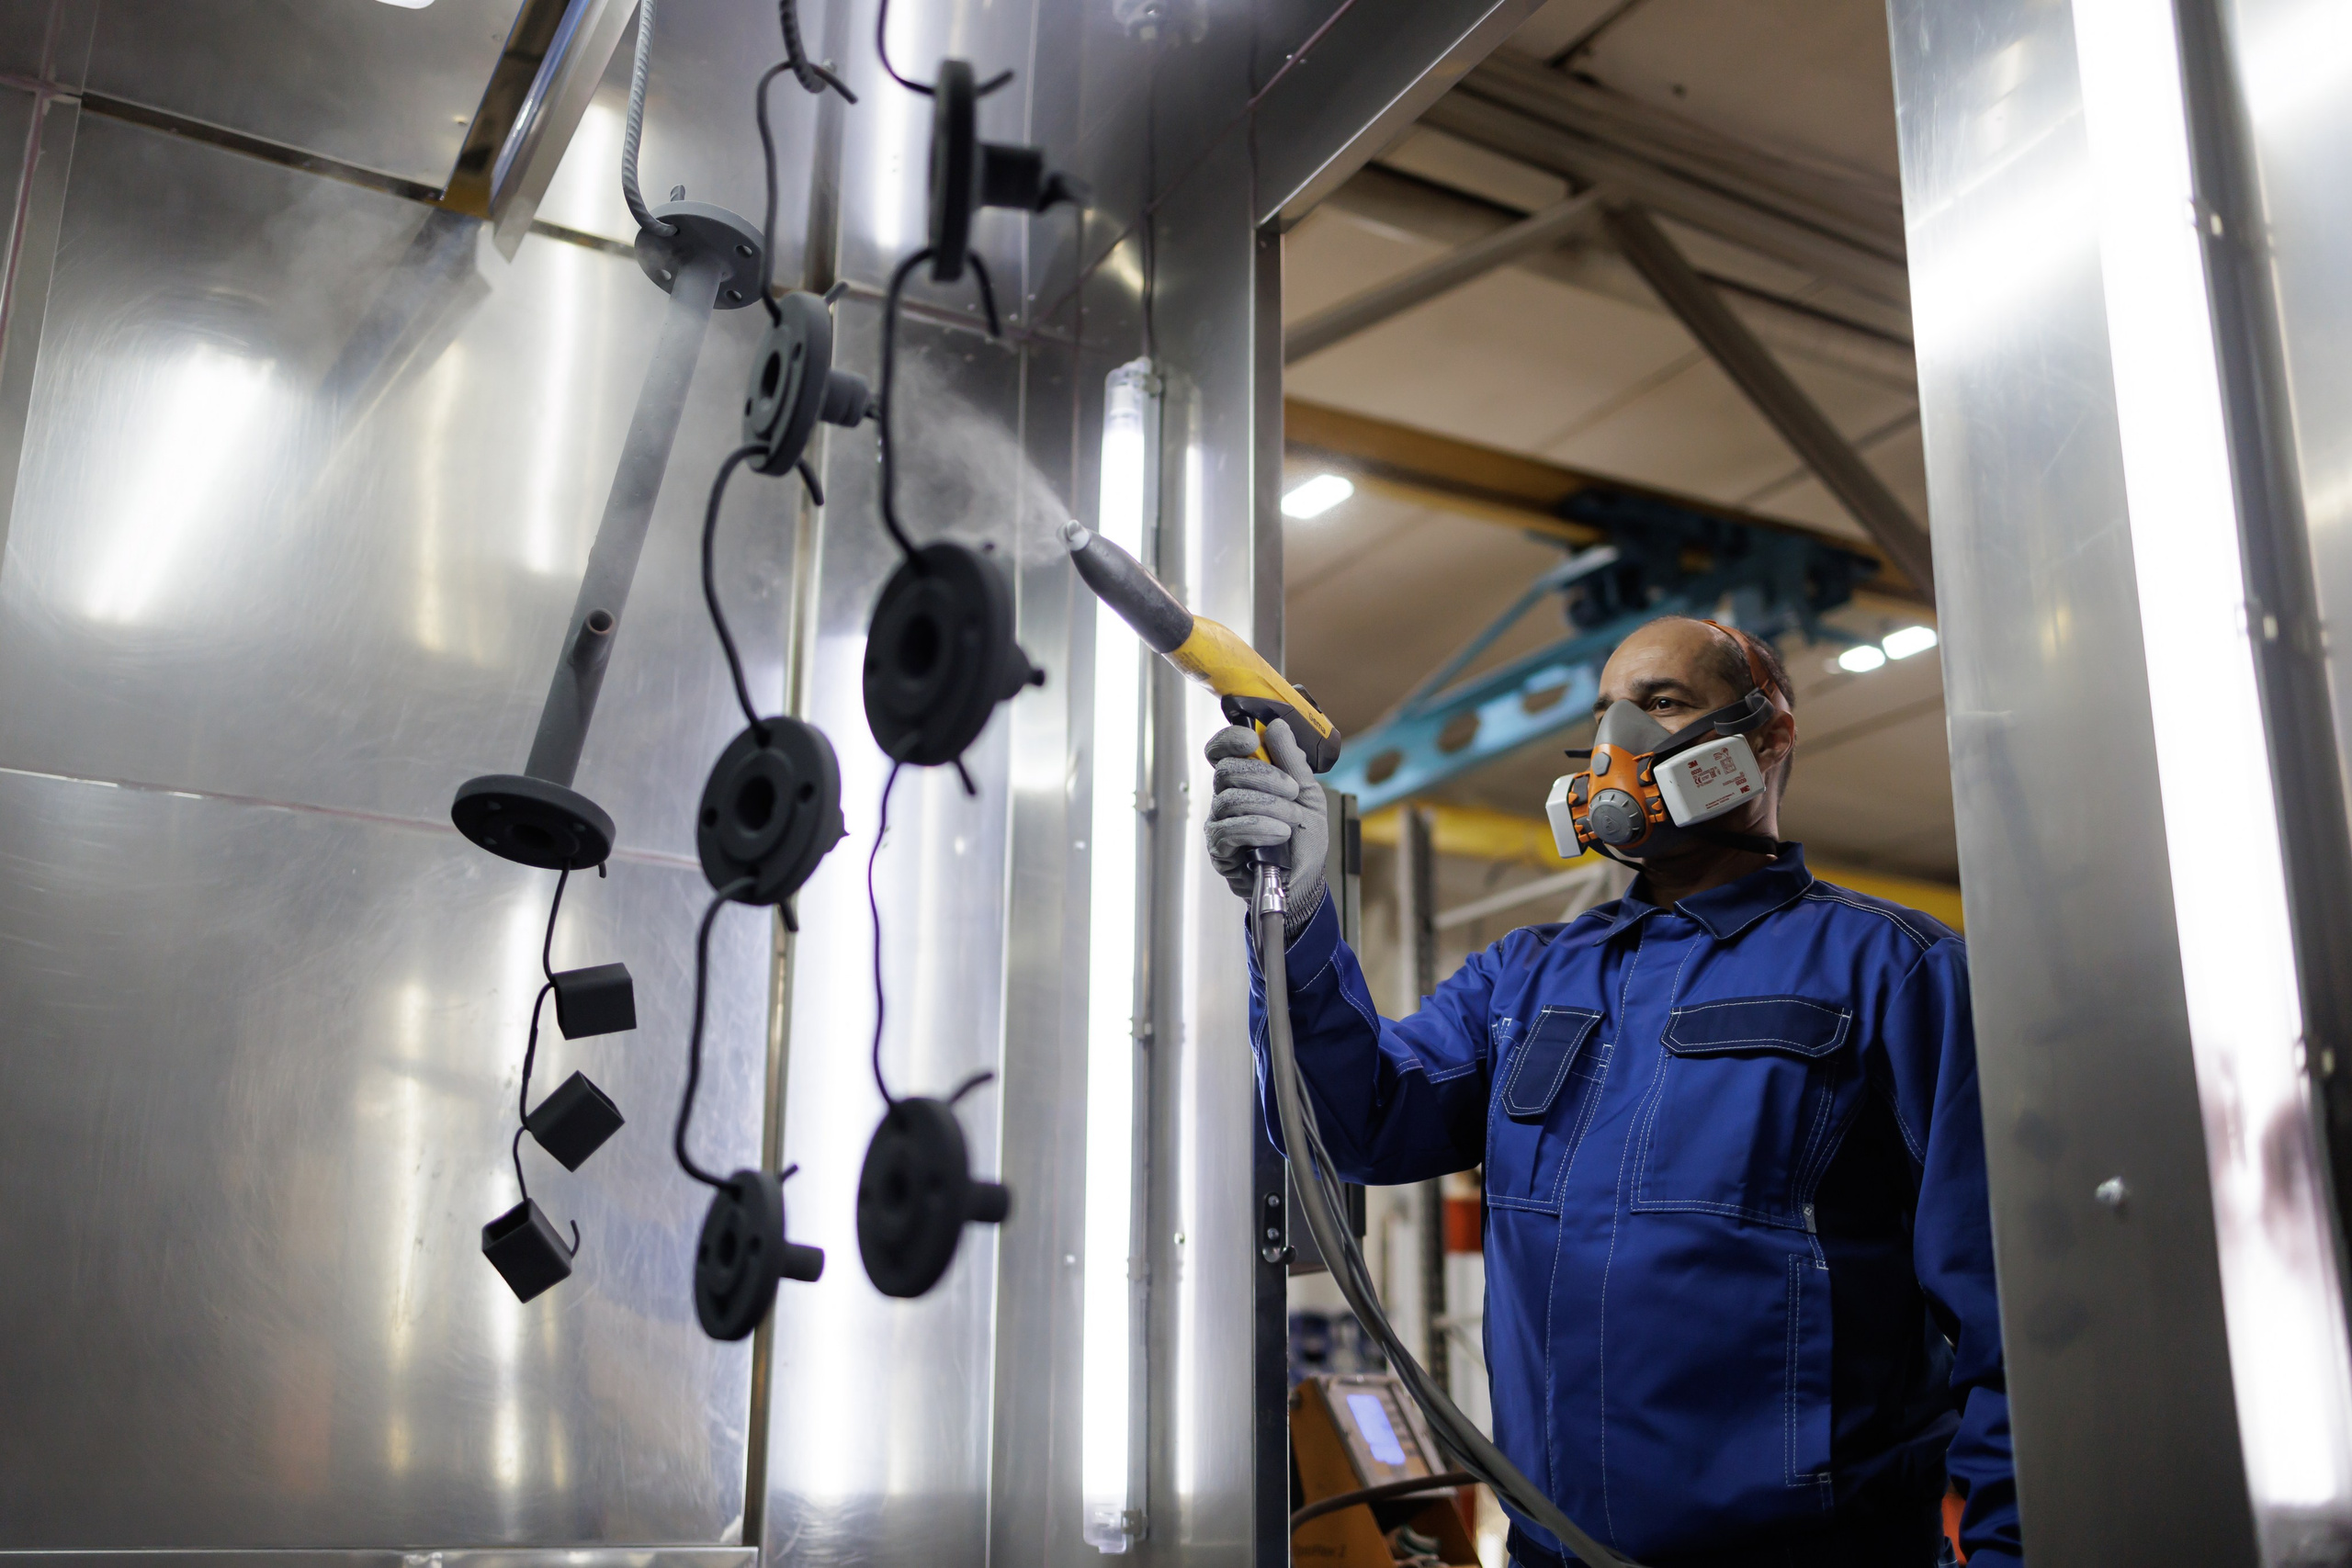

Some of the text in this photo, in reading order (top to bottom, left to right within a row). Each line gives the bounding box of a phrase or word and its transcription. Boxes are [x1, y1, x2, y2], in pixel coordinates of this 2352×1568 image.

[1309, 713, 1326, 734] Gema
[1688, 760, 1698, 769] 3M
[1740, 785, 1750, 794] 3M
